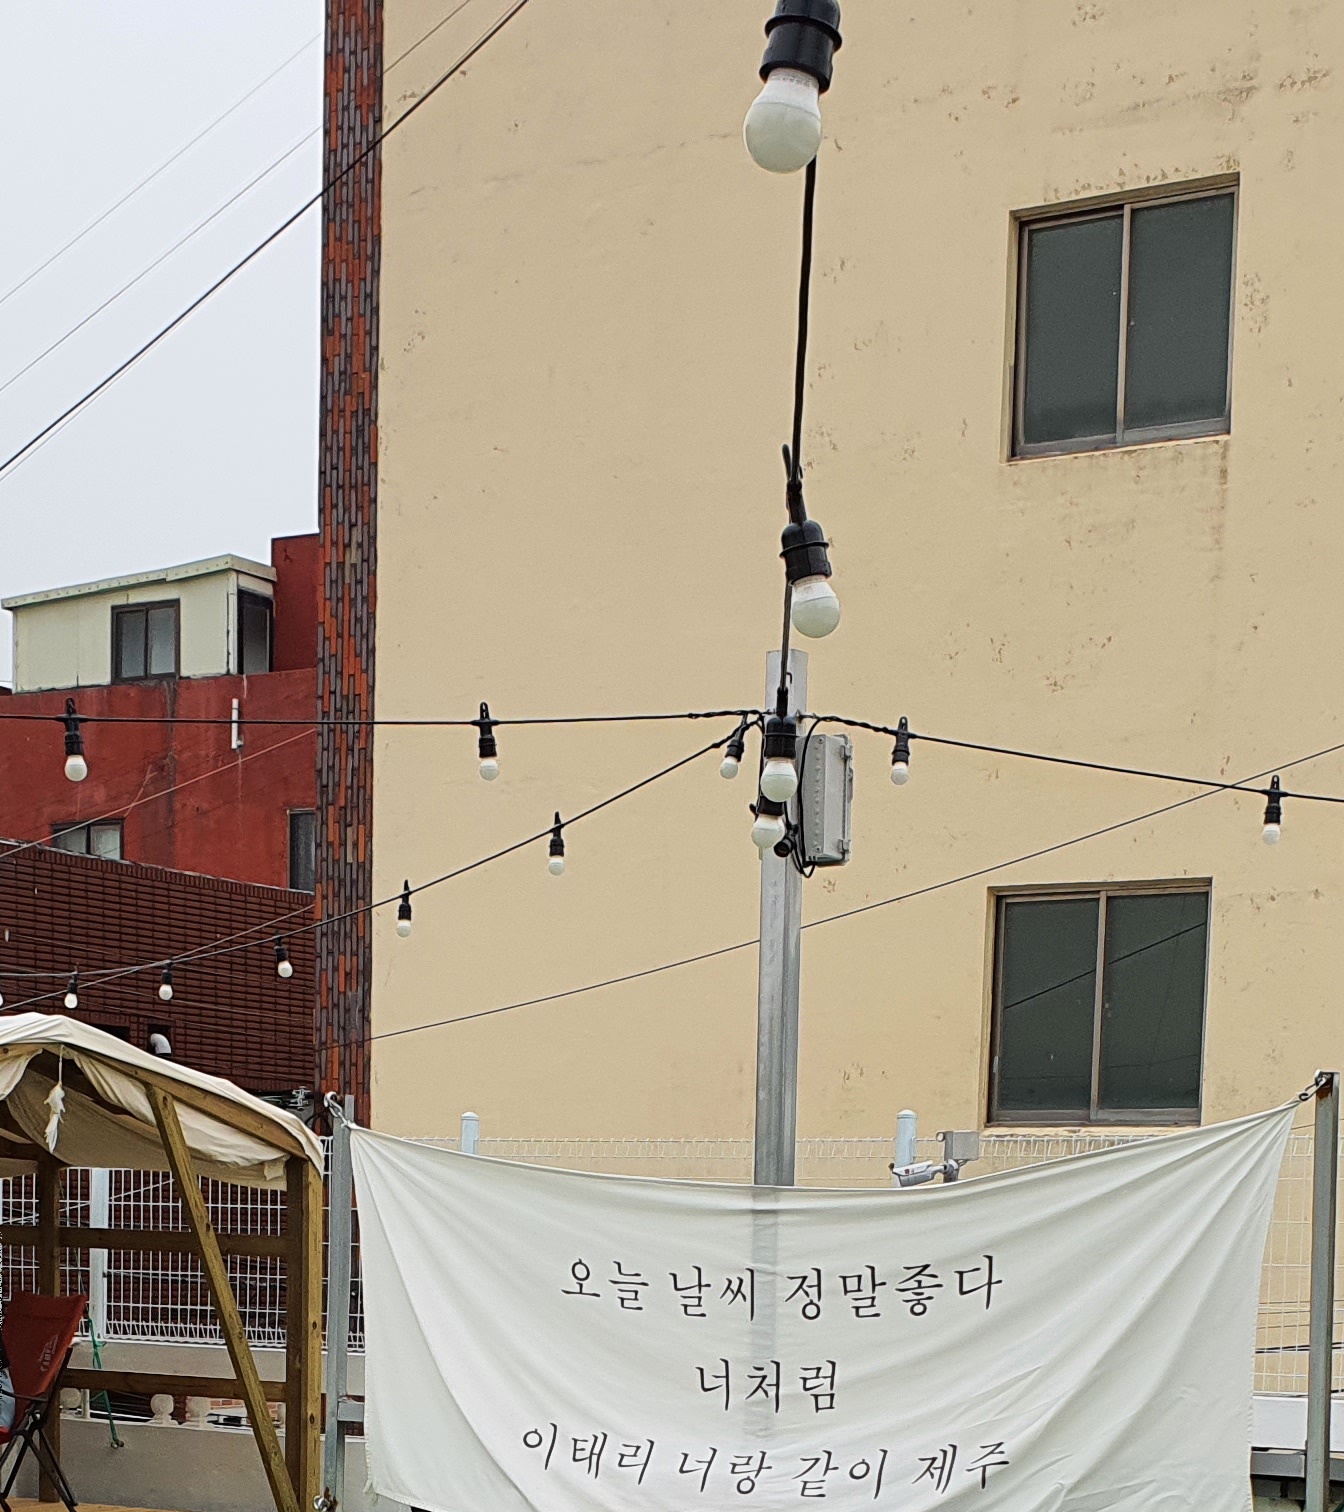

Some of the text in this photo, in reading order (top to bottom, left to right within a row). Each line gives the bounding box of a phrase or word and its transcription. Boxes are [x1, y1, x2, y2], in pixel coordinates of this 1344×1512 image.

[560, 1257, 651, 1311] 오늘
[668, 1264, 756, 1322] 날씨
[694, 1357, 839, 1414] 너처럼
[522, 1422, 1010, 1500] 이태리 너랑 같이 제주
